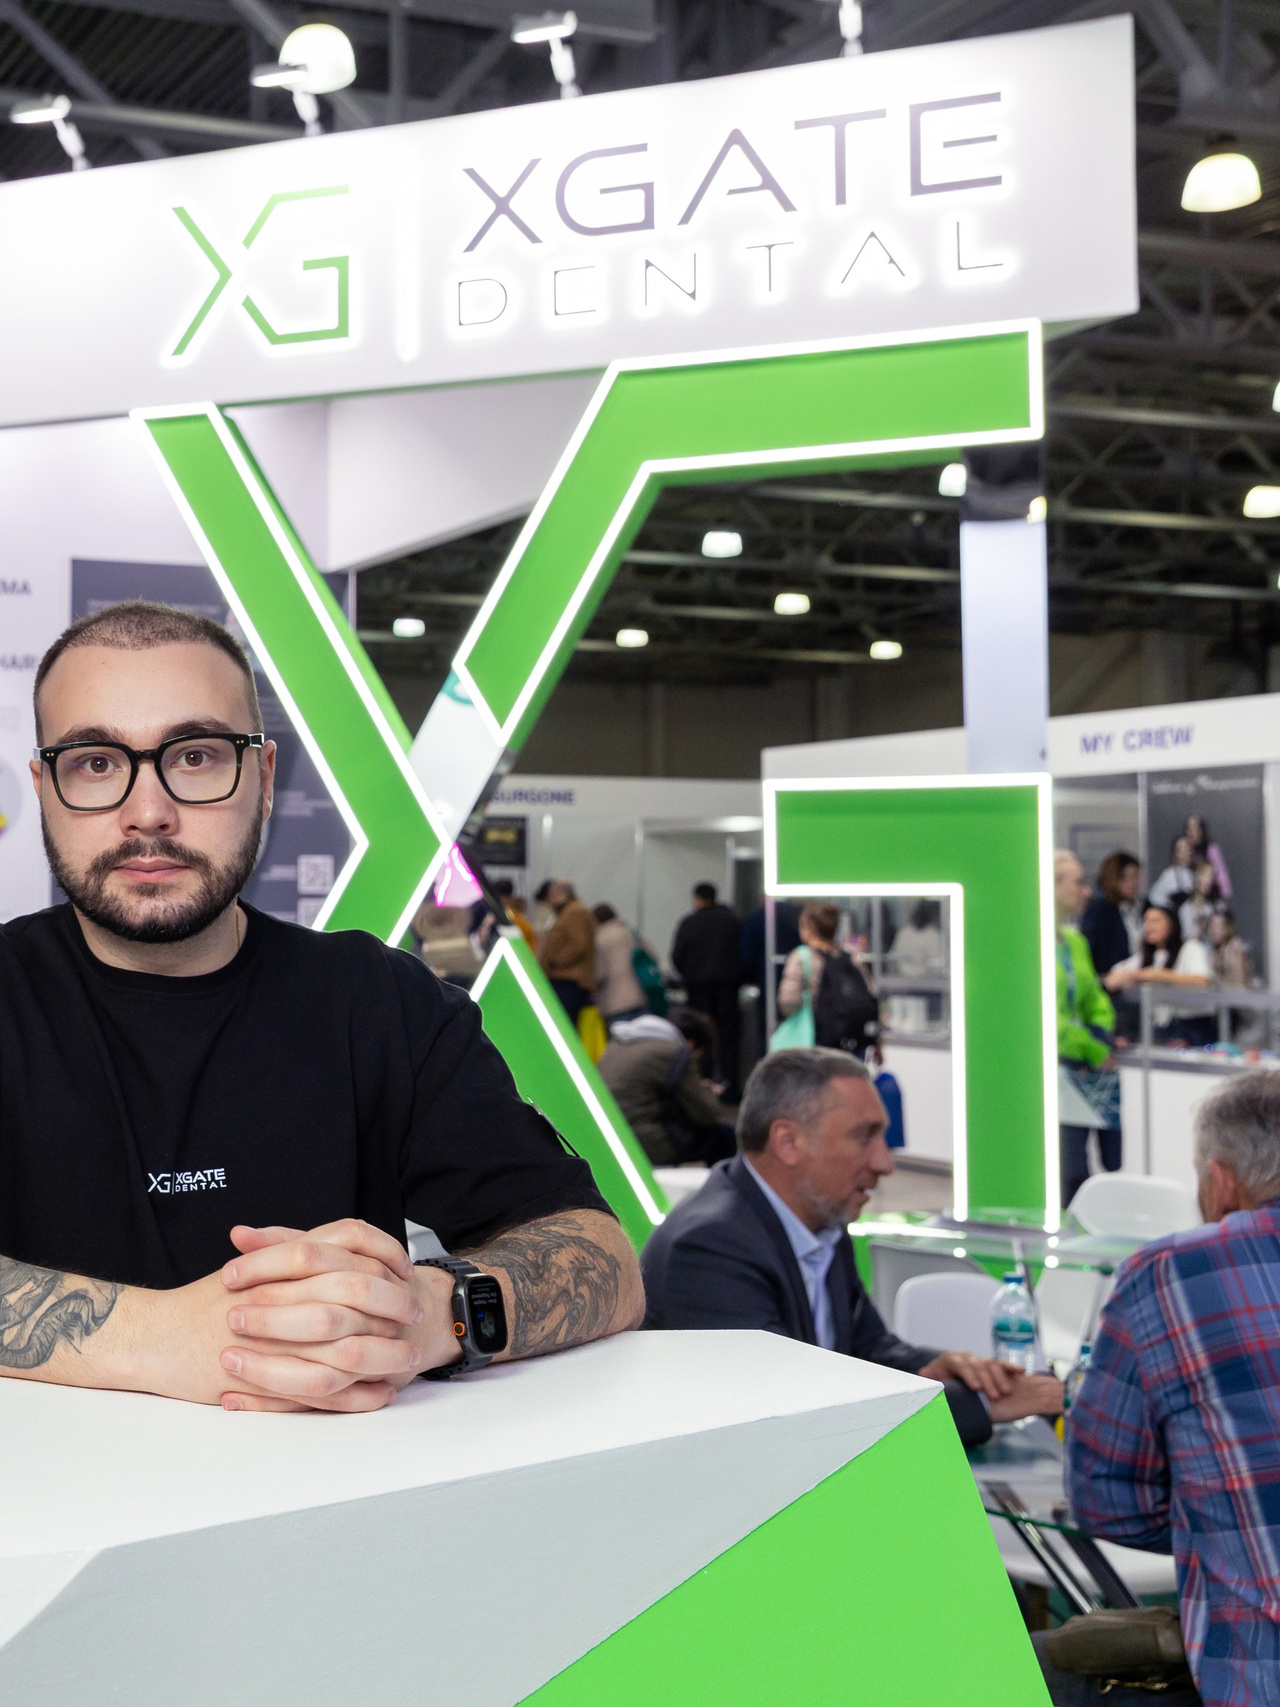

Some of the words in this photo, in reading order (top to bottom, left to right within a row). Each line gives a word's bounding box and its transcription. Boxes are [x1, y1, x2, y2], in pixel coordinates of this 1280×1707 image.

[462, 91, 1004, 253] XGATE
[456, 220, 1006, 328] DENTAL
[1081, 733, 1114, 754] MY
[147, 1172, 171, 1193] XG
[175, 1167, 226, 1184] XGATE
[175, 1180, 227, 1193] DENTAL
